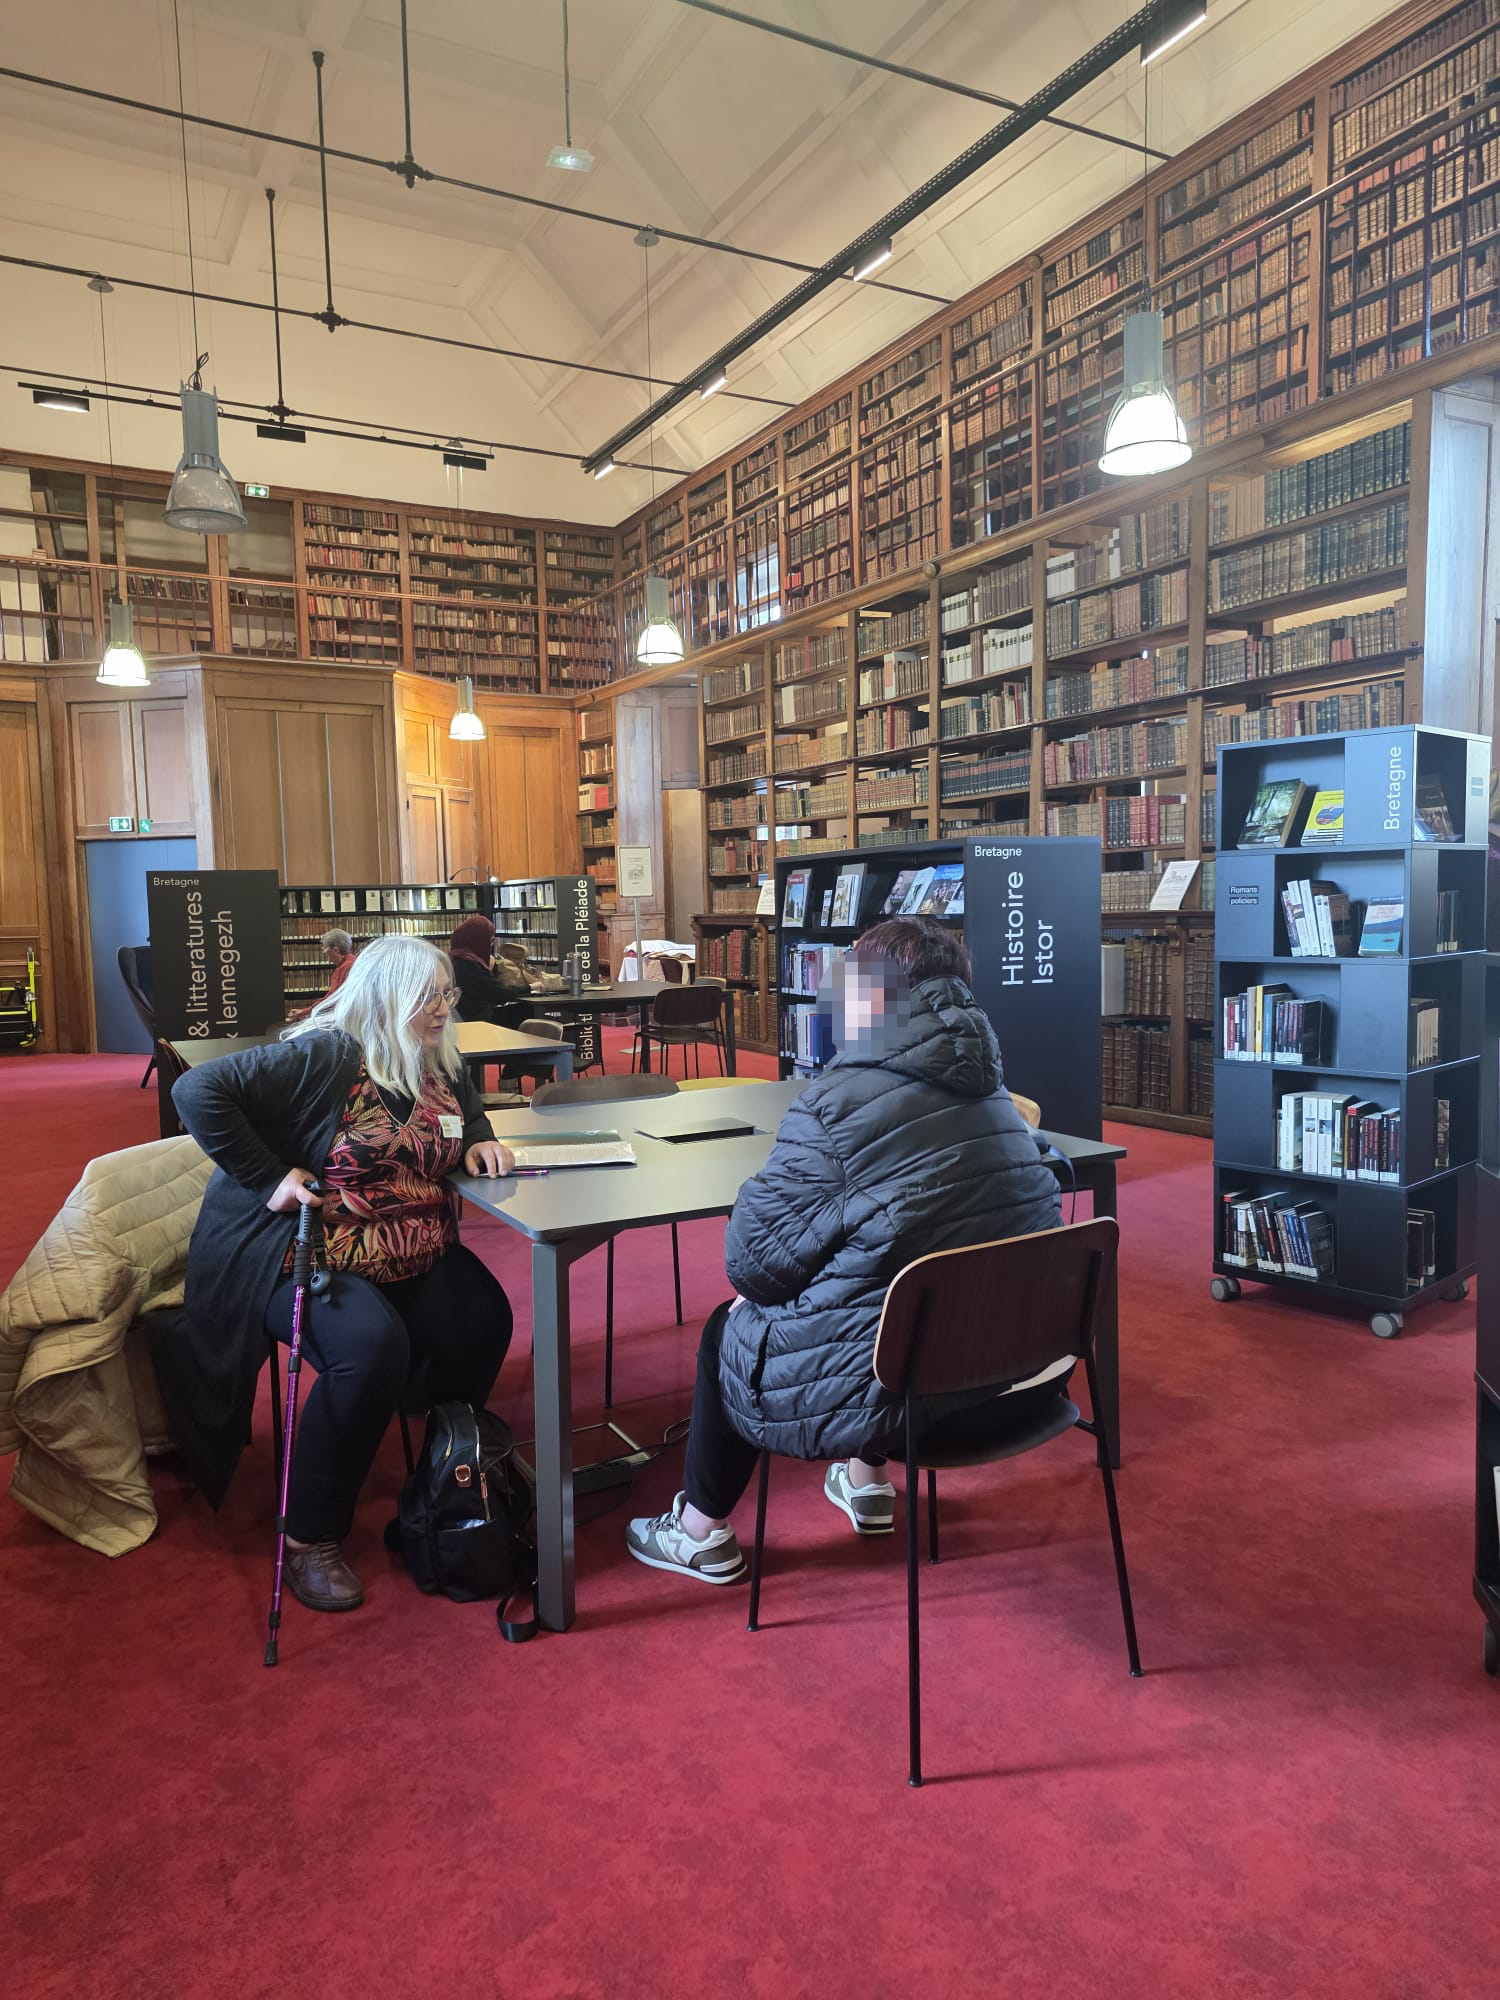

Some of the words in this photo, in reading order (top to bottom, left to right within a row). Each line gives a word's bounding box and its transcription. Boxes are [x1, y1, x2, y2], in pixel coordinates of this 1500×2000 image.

[1384, 746, 1406, 830] Bretagne
[974, 845, 1022, 860] Bretagne
[153, 877, 200, 888] Bretagne
[1230, 886, 1258, 894] Romans
[573, 879, 591, 931] Pléiade
[1230, 897, 1258, 905] policiers
[1001, 871, 1024, 985] Histoire
[575, 935, 591, 947] la
[1031, 919, 1054, 984] Istor
[210, 910, 241, 1025] lennegezh
[188, 1020, 210, 1037] &
